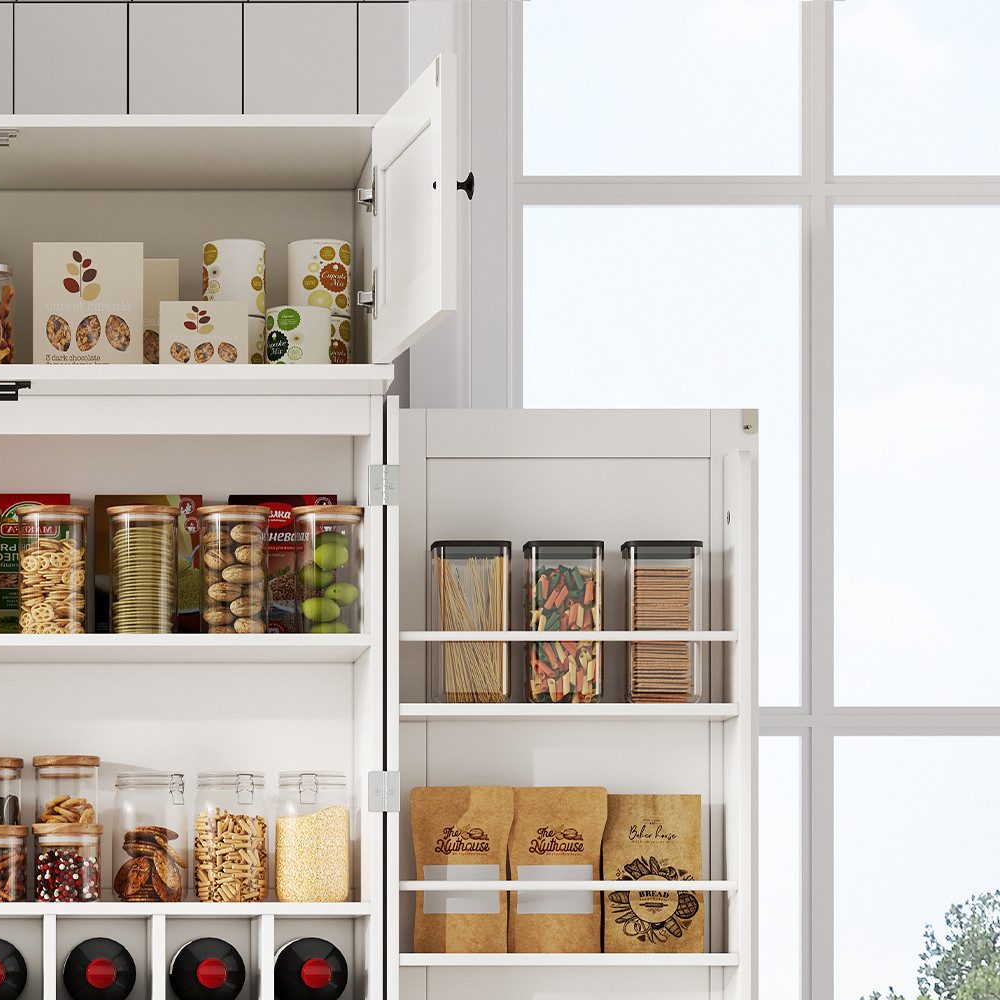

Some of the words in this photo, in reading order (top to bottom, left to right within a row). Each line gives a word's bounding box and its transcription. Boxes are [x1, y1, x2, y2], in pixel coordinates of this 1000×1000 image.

[443, 826, 462, 840] The
[537, 826, 555, 840] The
[435, 837, 490, 855] Nuthouse
[529, 838, 584, 855] Nuthouse
[639, 890, 670, 898] BREAD
